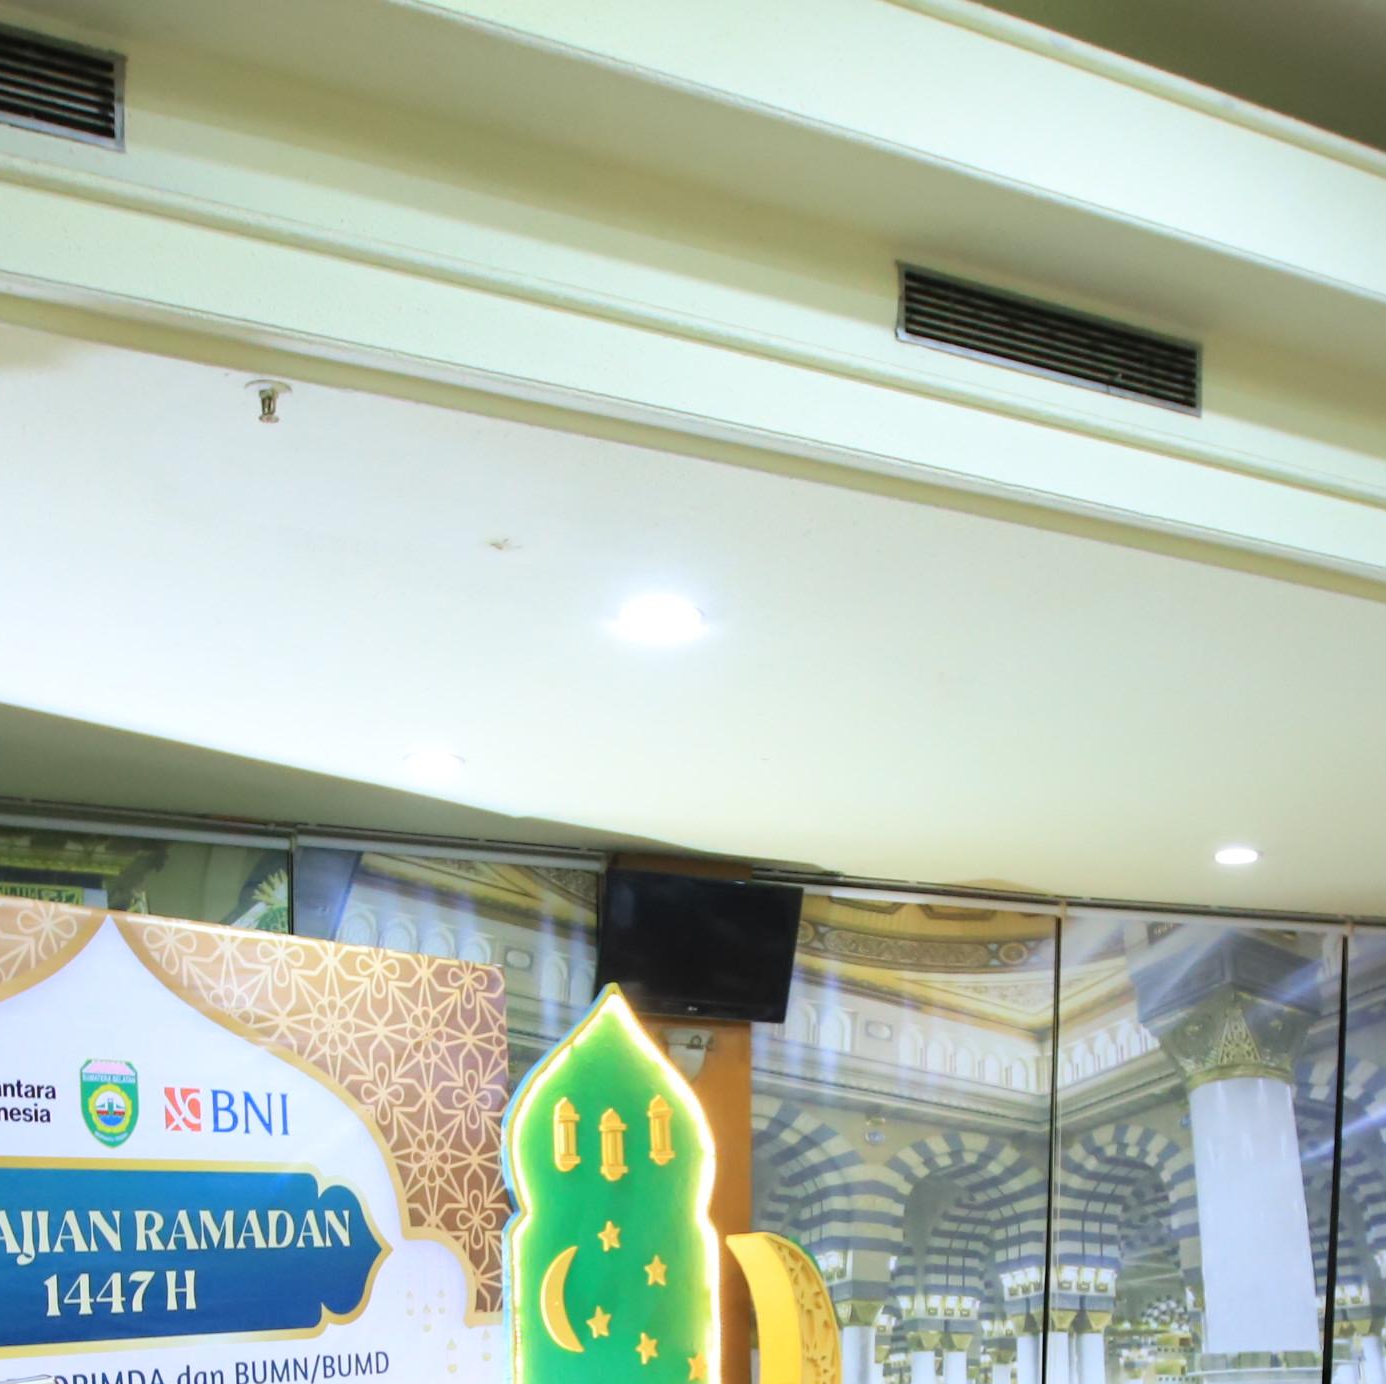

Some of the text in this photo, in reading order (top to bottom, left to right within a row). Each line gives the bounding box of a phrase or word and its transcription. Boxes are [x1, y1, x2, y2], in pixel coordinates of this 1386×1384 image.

[211, 1089, 290, 1136] BNI
[134, 1209, 351, 1251] RAMADAN
[44, 1269, 197, 1317] 1447 H
